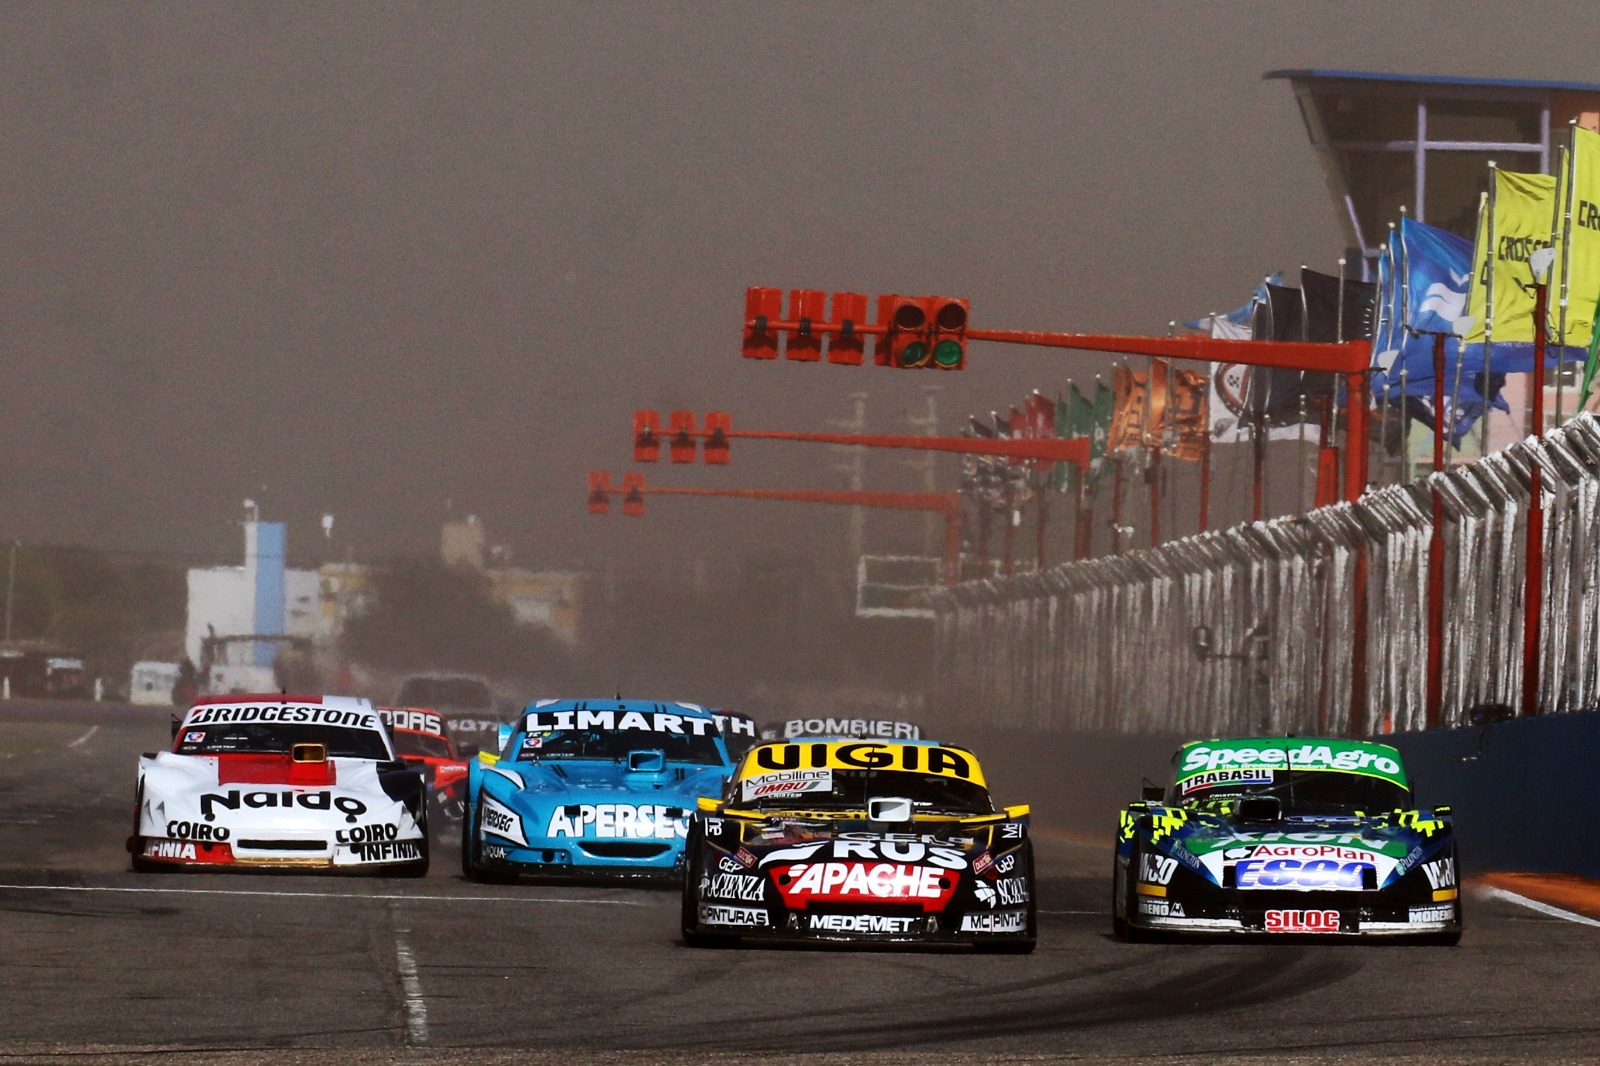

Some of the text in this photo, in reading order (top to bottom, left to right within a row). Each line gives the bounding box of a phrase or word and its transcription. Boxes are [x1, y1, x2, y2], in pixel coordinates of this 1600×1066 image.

[1578, 199, 1600, 232] CR
[1498, 236, 1550, 263] CROS
[188, 707, 377, 729] BRIDGESTONE
[784, 718, 920, 741] BOMBIERI
[1182, 746, 1400, 775] SpeedAgro
[745, 771, 830, 788] Mobiline
[1185, 769, 1272, 789] TRABASIL
[200, 790, 368, 816] Naldo
[166, 820, 231, 841] COIRO
[335, 822, 398, 843] COIRO
[1252, 845, 1376, 862] AgroPlan
[788, 862, 945, 898] APACHE
[809, 915, 914, 932] MEDEMET
[1265, 910, 1340, 927] SILOC
